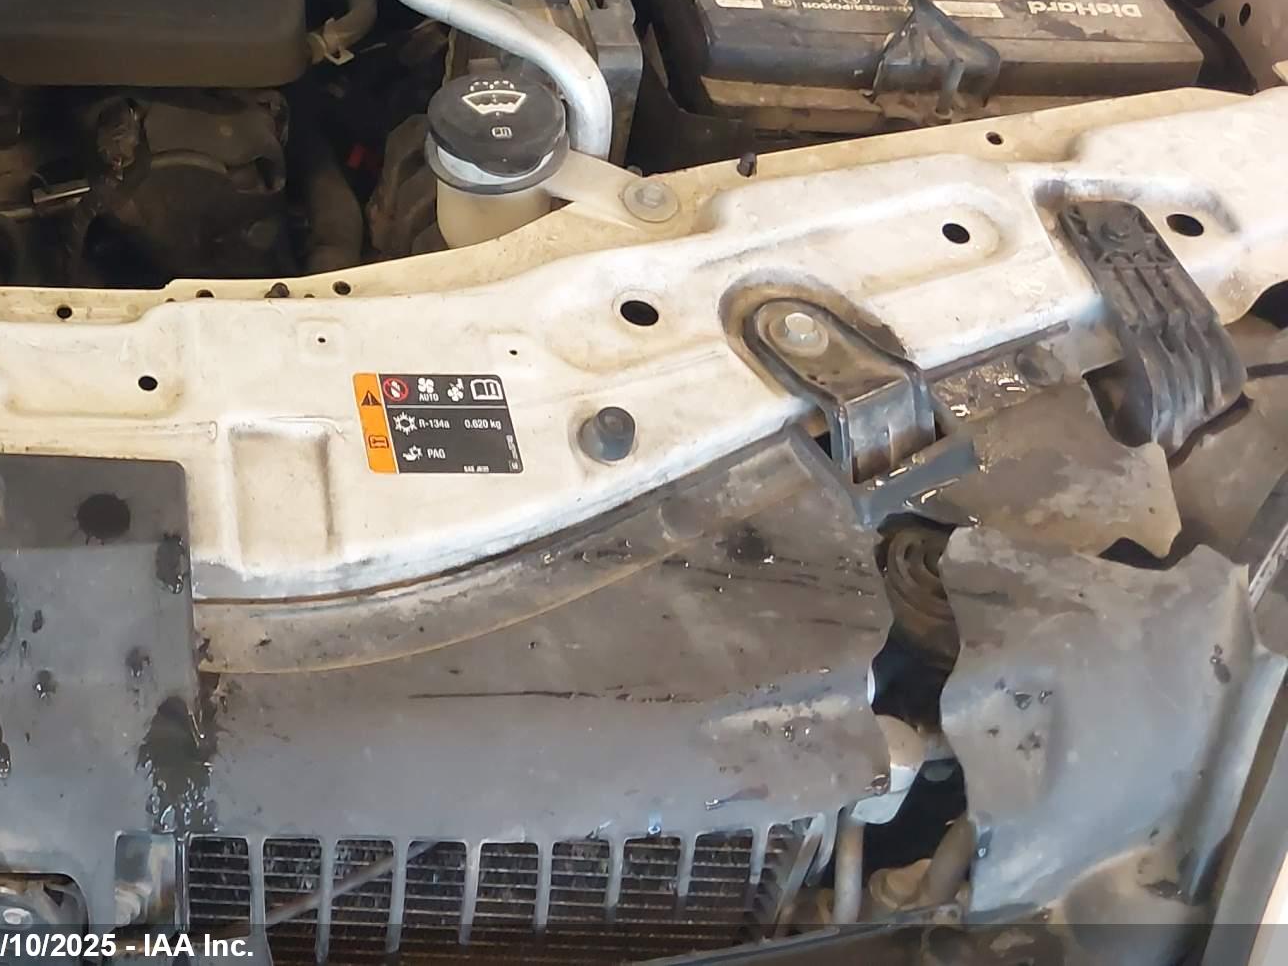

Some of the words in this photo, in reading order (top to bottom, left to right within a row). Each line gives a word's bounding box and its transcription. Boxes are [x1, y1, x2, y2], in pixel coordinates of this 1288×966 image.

[1027, 0, 1142, 18] DieHard
[419, 393, 439, 402] AUTO
[419, 419, 450, 428] R-134a
[464, 419, 488, 428] 0.620
[490, 419, 502, 430] kg
